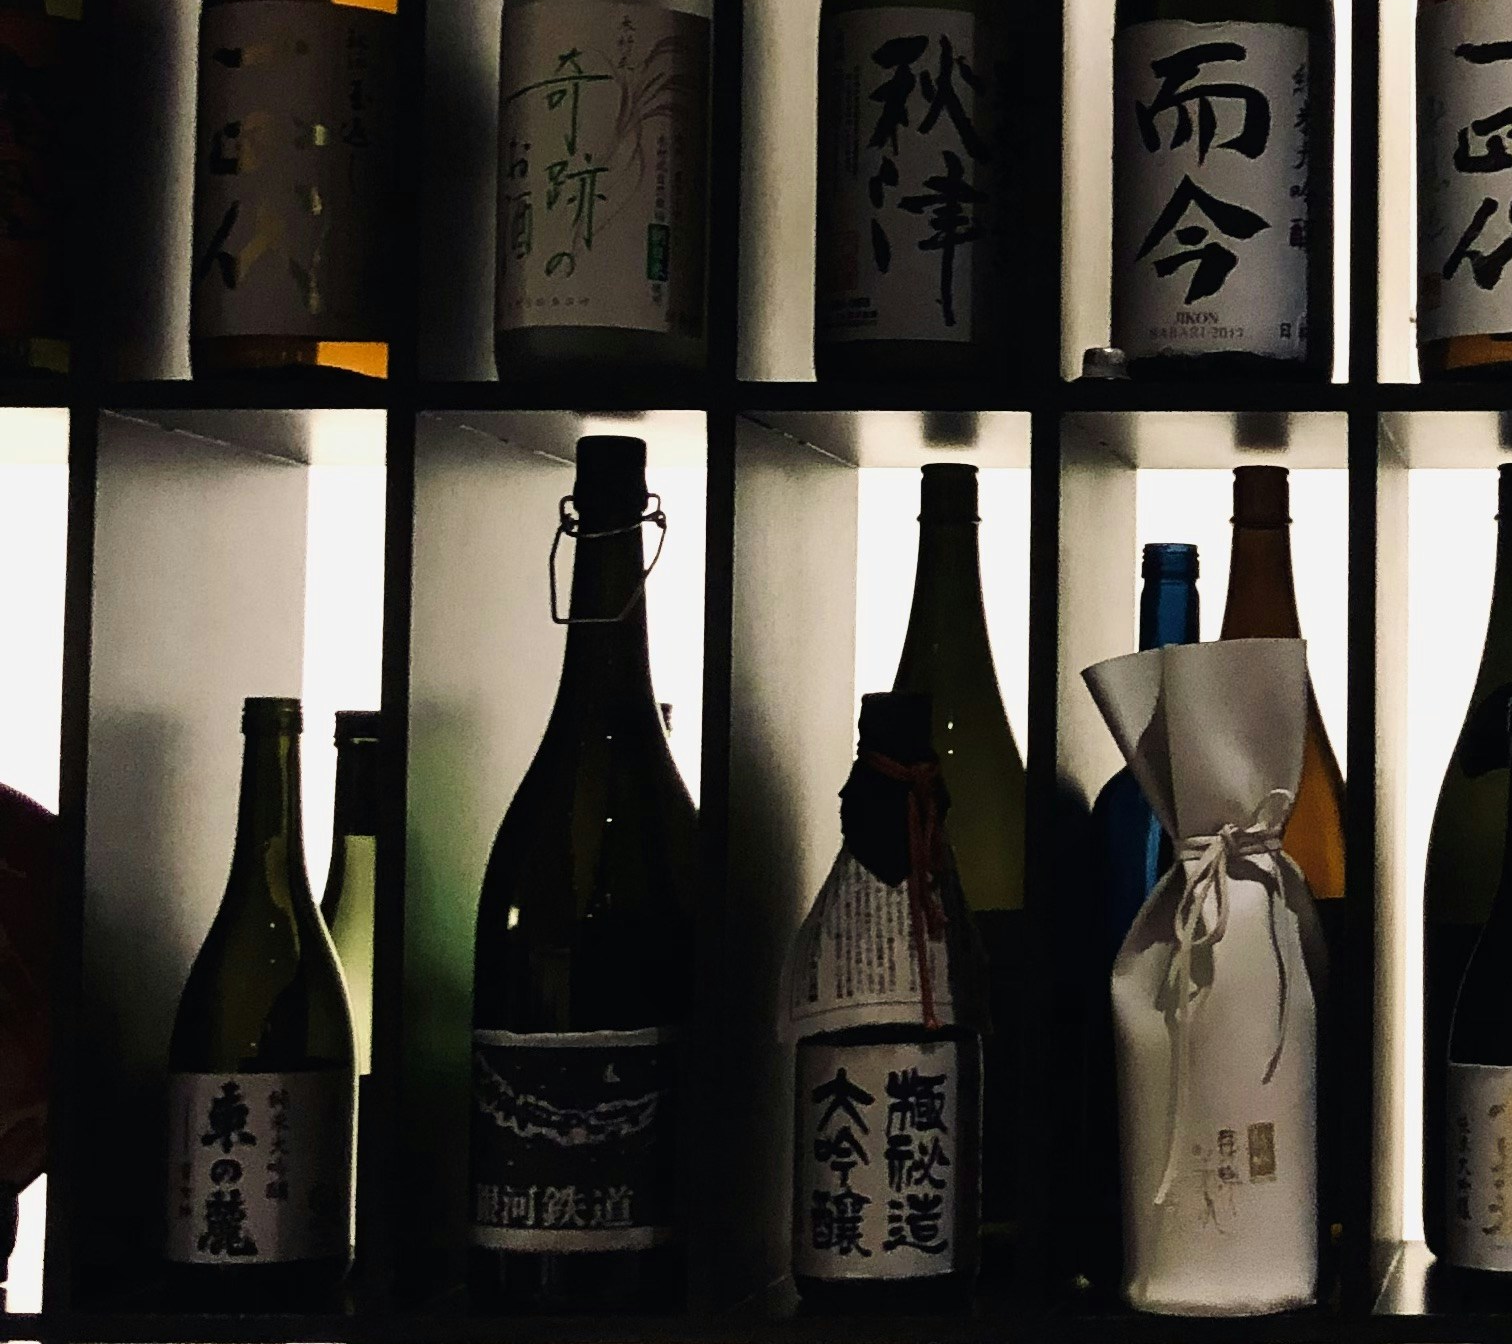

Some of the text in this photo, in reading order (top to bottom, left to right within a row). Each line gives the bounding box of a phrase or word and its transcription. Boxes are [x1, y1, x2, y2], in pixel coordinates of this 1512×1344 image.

[507, 47, 614, 278] 奇跡の
[1134, 42, 1271, 305] 而今
[811, 1067, 877, 1258] 大吟醸
